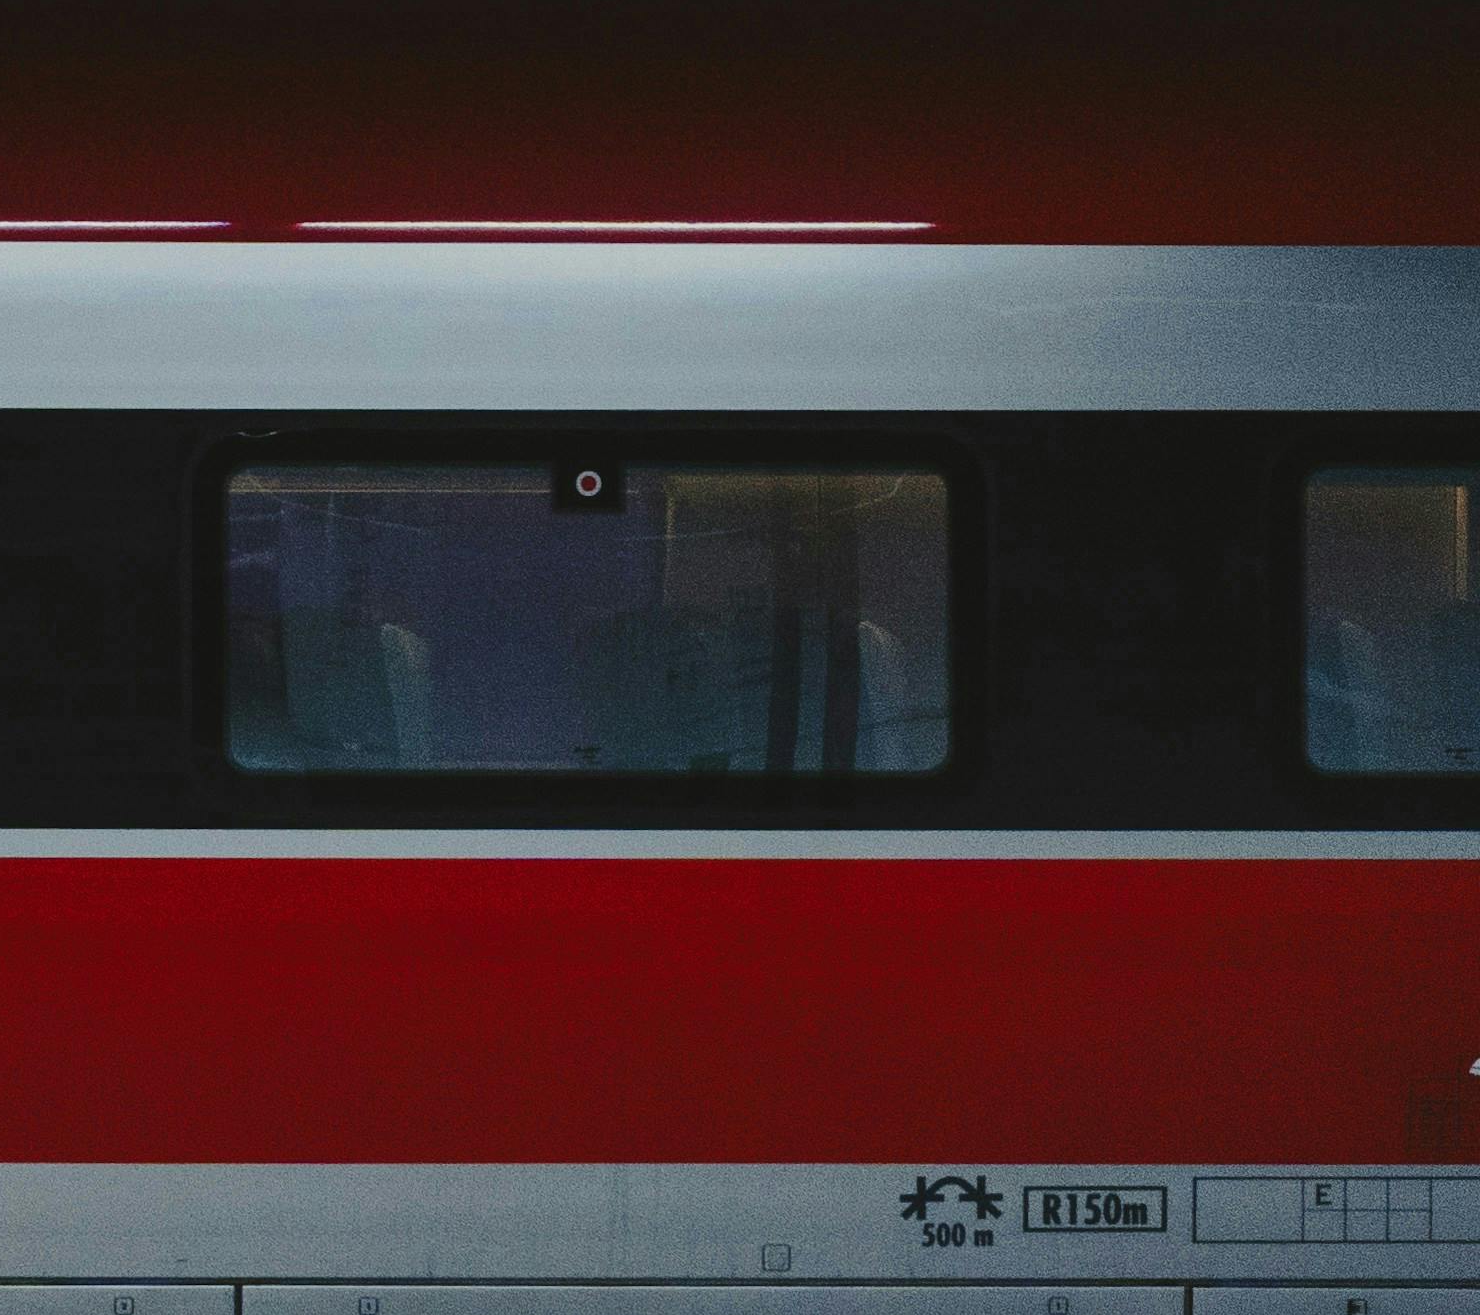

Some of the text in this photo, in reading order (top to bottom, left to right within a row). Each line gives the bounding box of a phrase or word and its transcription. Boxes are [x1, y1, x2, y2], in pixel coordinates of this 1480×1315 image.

[1316, 1184, 1333, 1205] E
[1042, 1193, 1149, 1226] R150m
[922, 1222, 995, 1248] 500 m
